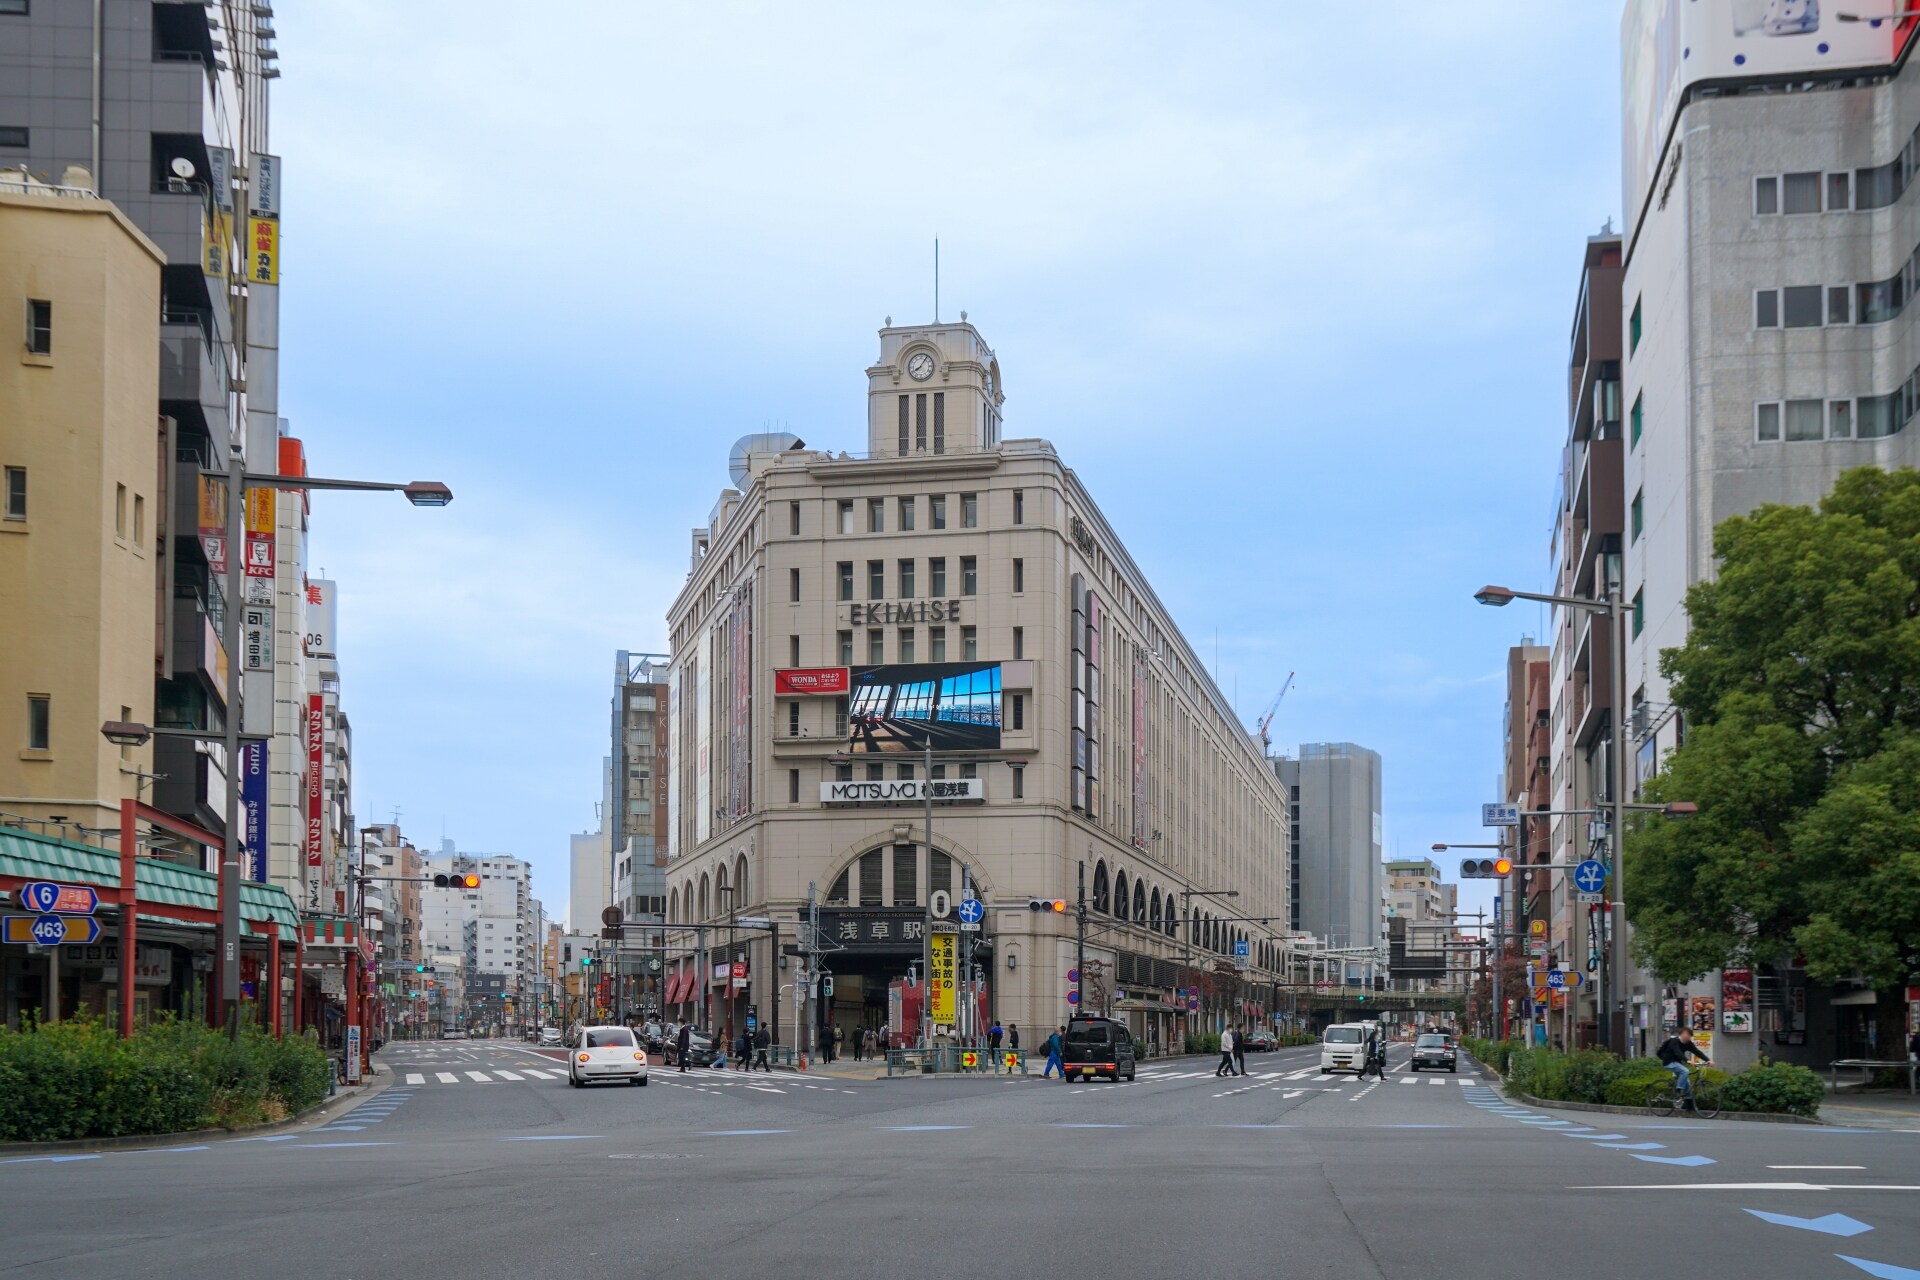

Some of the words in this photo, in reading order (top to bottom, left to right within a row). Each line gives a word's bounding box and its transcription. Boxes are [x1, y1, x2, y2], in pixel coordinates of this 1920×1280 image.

[248, 566, 274, 576] KFC
[851, 600, 960, 625] EKIMISE
[309, 710, 322, 752] カラオケ
[657, 700, 669, 805] EKIMISE
[248, 800, 258, 842] みずほ銀行
[1487, 808, 1517, 818] 吾妻橋
[309, 818, 322, 861] カラオケ
[41, 887, 53, 905] 6
[34, 922, 63, 938] 463
[838, 921, 922, 940] 浅草駅
[943, 937, 953, 989] 交通事故の
[1548, 975, 1563, 984] 463
